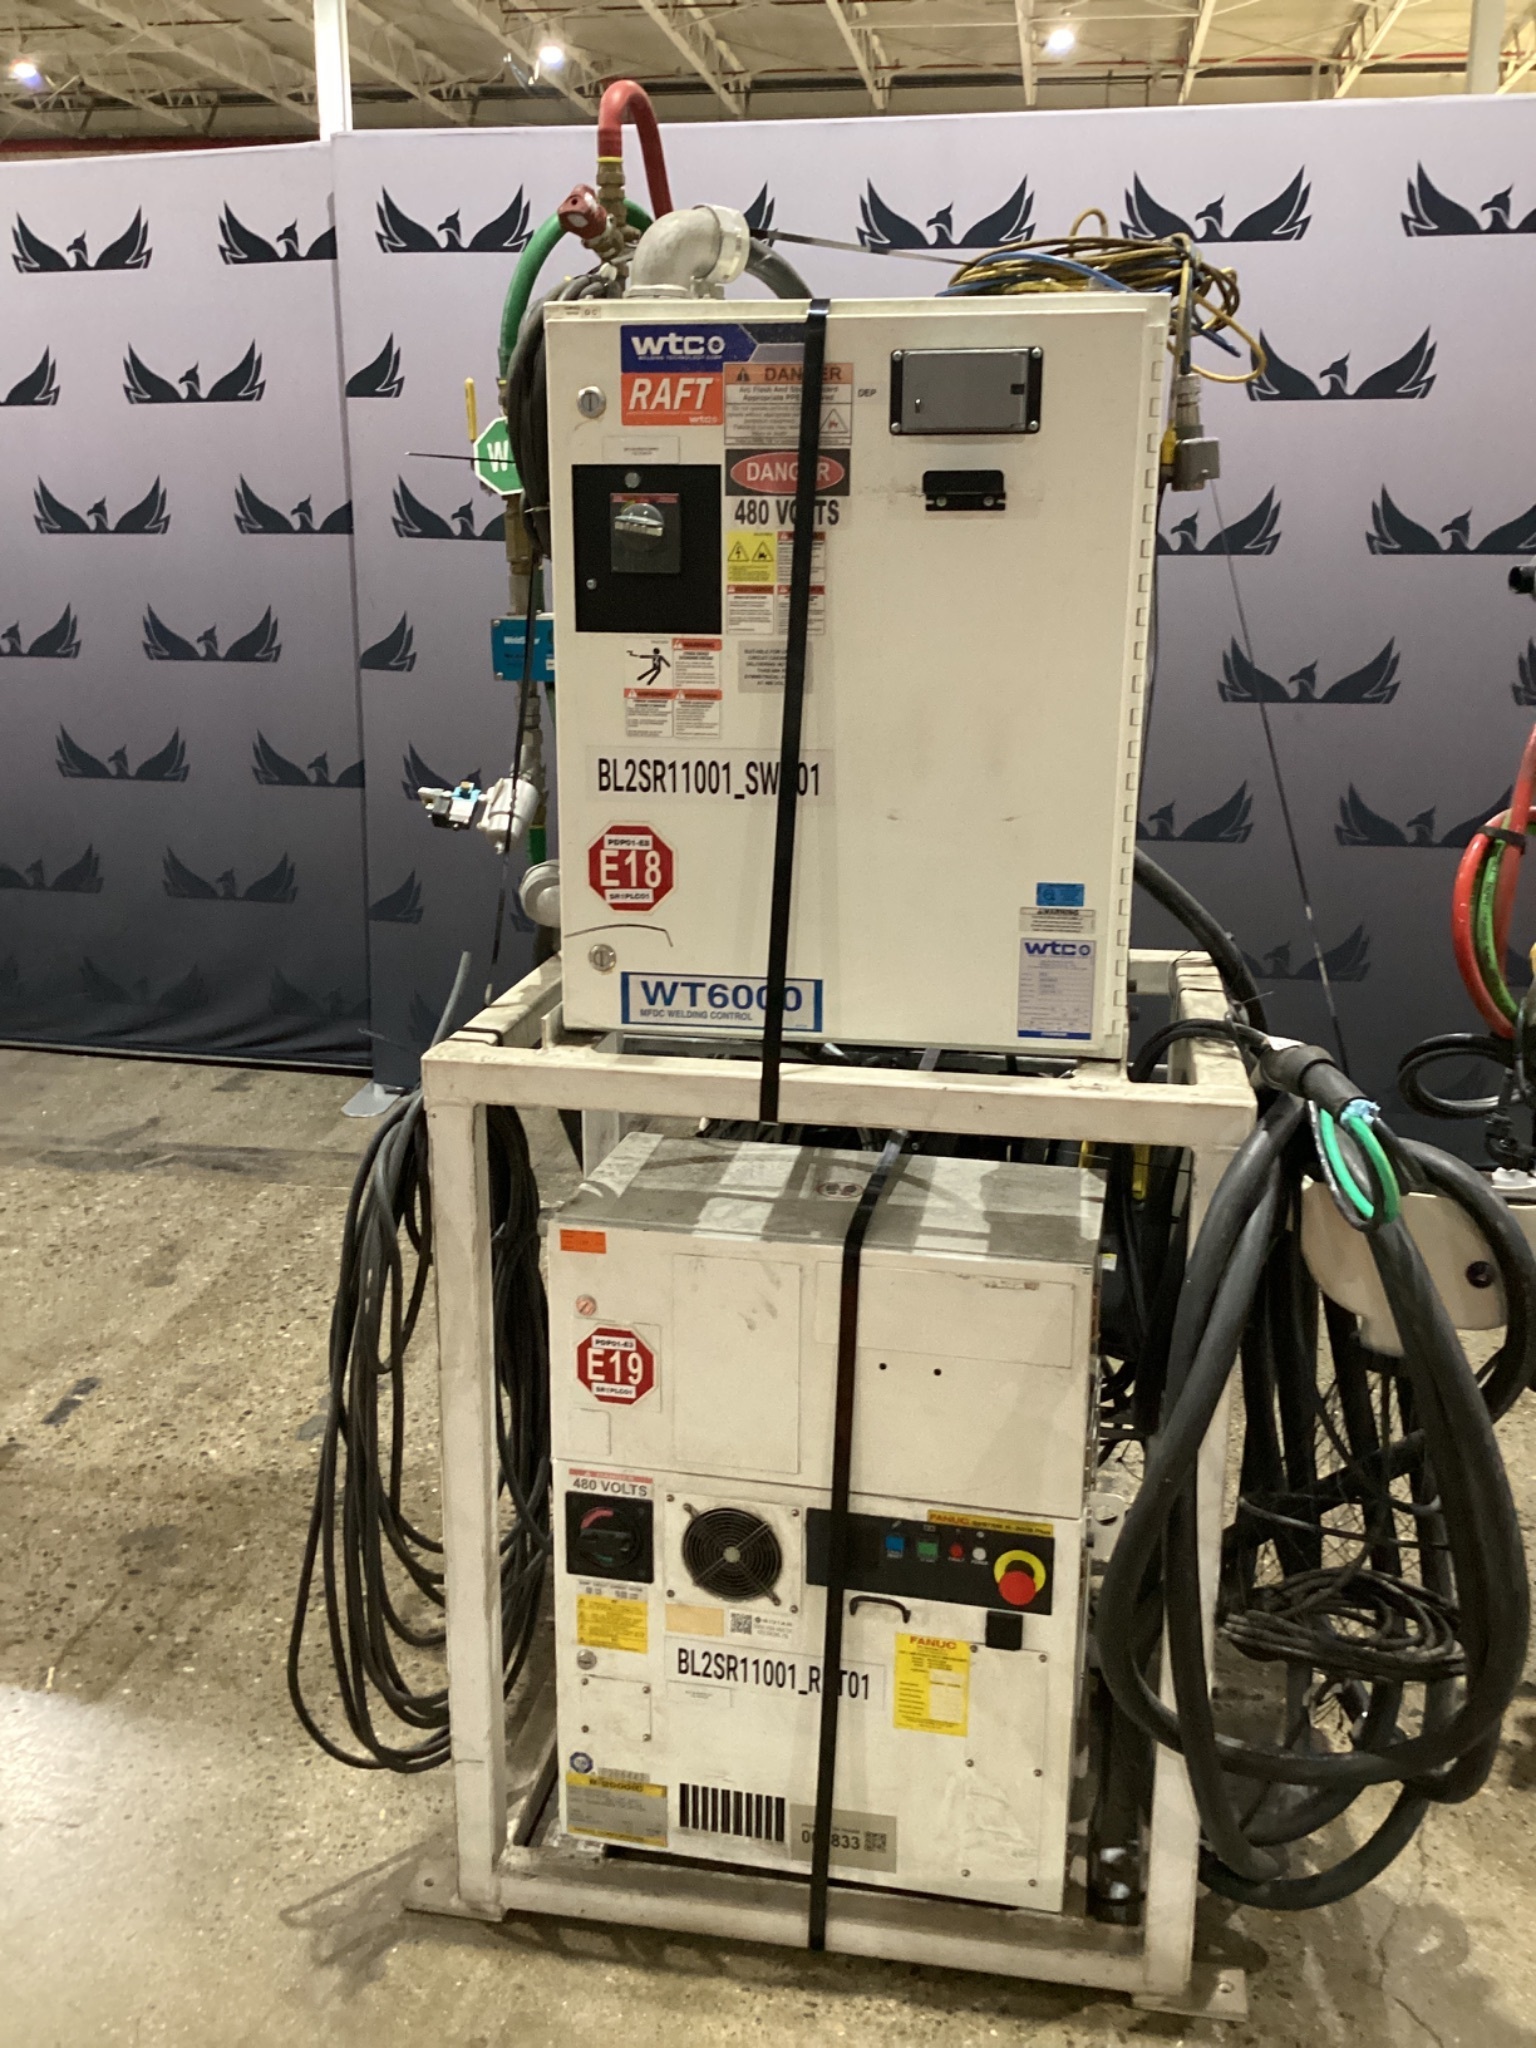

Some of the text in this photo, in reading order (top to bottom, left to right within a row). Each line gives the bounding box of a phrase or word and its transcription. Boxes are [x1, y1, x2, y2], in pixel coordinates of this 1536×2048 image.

[631, 333, 726, 355] wtco
[764, 367, 842, 382] DANER
[628, 377, 714, 410] RAFT
[857, 388, 877, 398] DEP
[746, 461, 831, 482] DANGR
[734, 499, 840, 526] 480 VOTS
[598, 758, 820, 800] BL2SR11001_SW01
[600, 849, 662, 888] E18
[1024, 940, 1092, 957] wtco
[640, 1009, 753, 1021] MFDC WELDING CONTROL
[587, 1347, 644, 1386] E19
[572, 1478, 648, 1498] 480 VOLTS
[910, 1635, 958, 1650] FANUC
[677, 1647, 870, 1700] BL2SR11001_RT01
[801, 1830, 861, 1851] 0833
